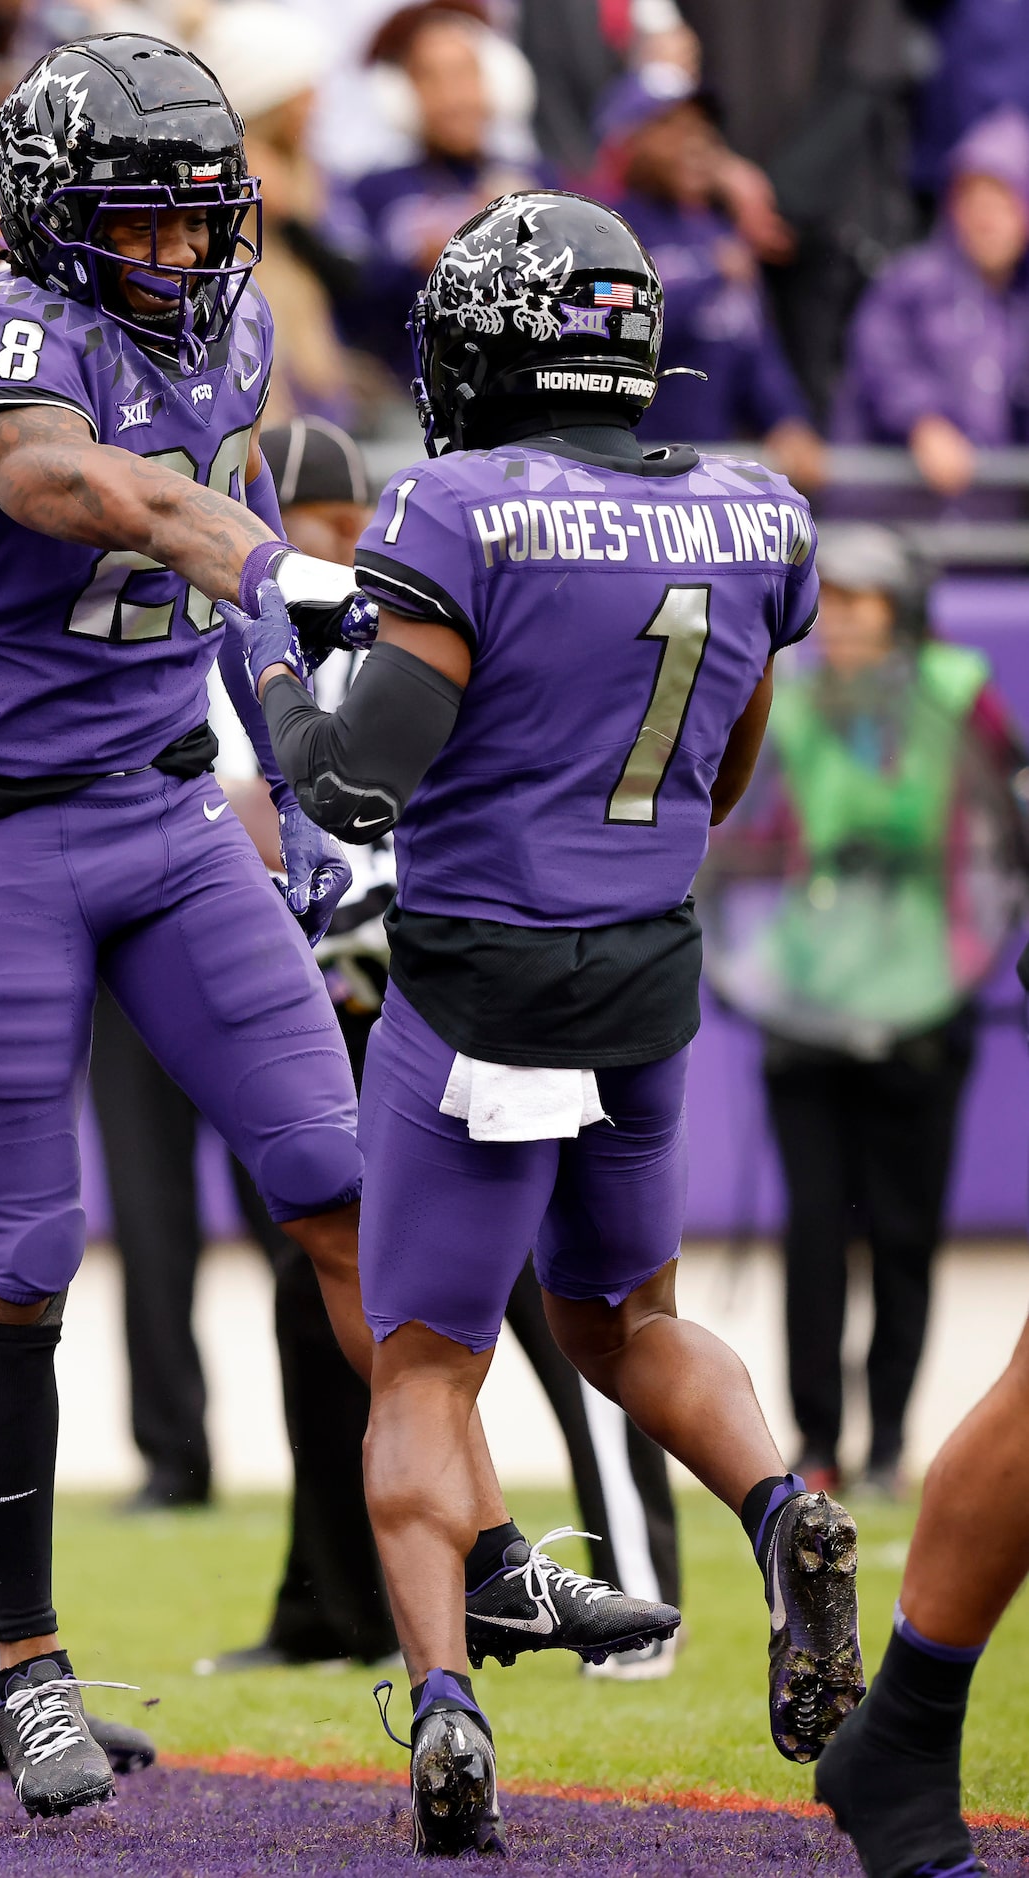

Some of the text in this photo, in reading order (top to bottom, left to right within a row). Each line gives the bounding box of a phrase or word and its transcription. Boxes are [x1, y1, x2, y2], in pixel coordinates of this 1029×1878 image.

[561, 306, 611, 337] XII
[190, 384, 213, 406] TCU
[536, 372, 656, 398] HORNED FROGS
[117, 398, 152, 432] XII
[383, 479, 418, 544] 1
[472, 499, 813, 569] HODGES-TOMLINSON
[603, 583, 712, 827] 1
